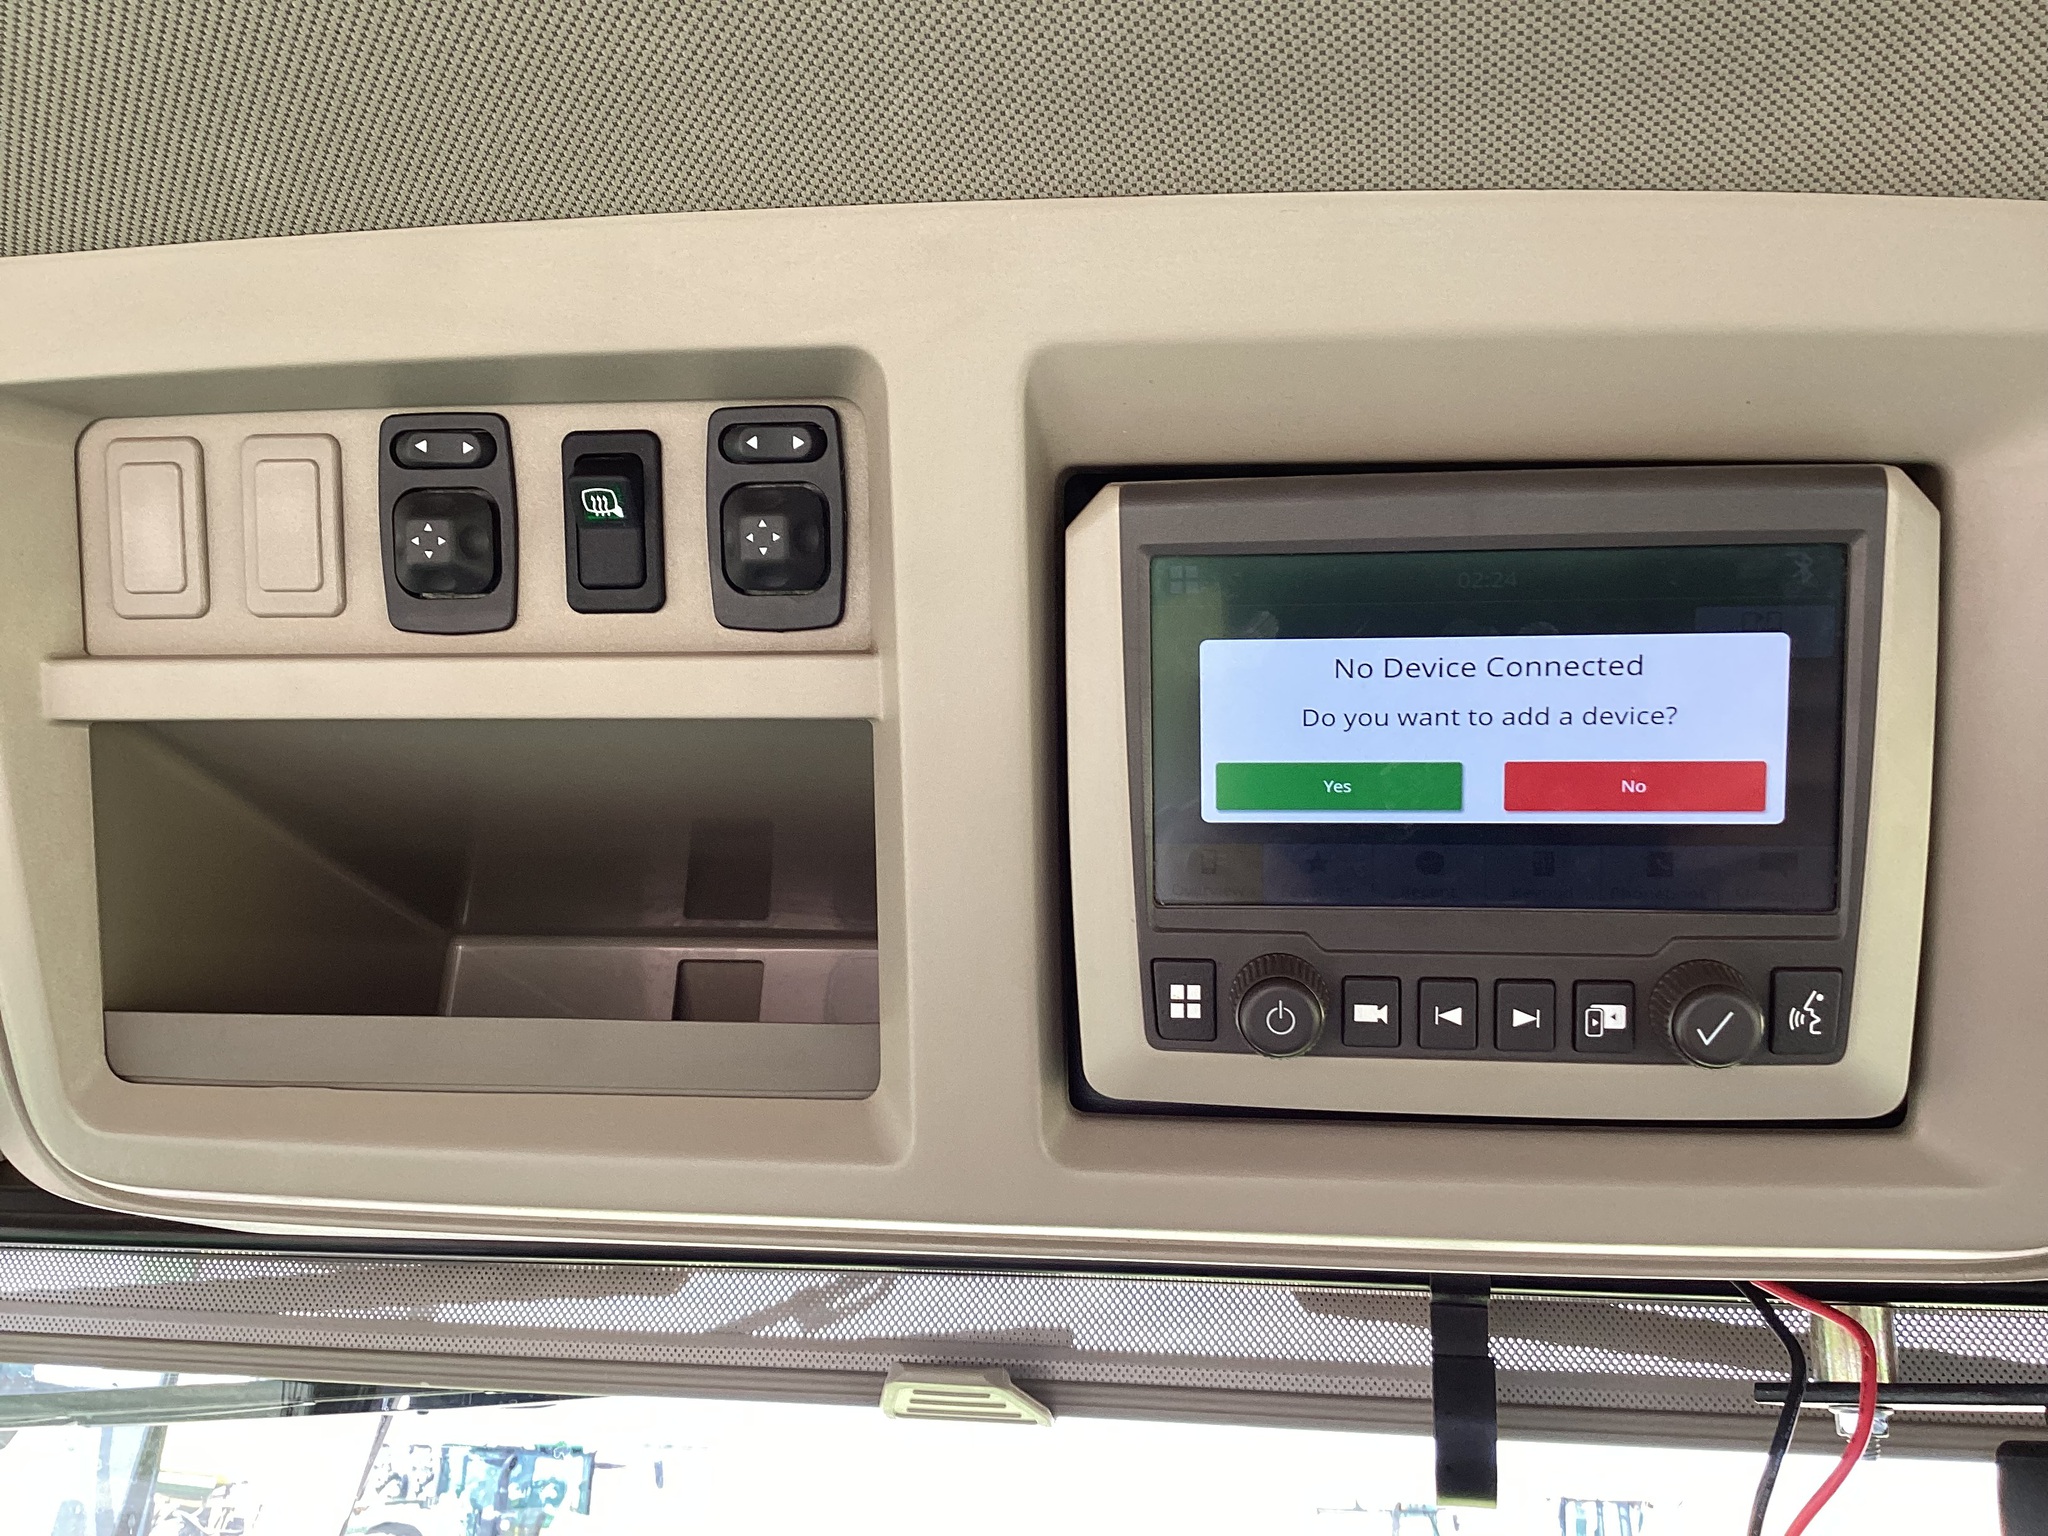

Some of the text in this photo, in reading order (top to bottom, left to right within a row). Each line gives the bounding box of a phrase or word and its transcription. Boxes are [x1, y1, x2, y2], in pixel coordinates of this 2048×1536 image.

[1334, 653, 1645, 680] No Device Connected
[1302, 705, 1679, 733] Do you want to add a device?
[1323, 779, 1353, 794] Yes
[1621, 779, 1648, 794] No
